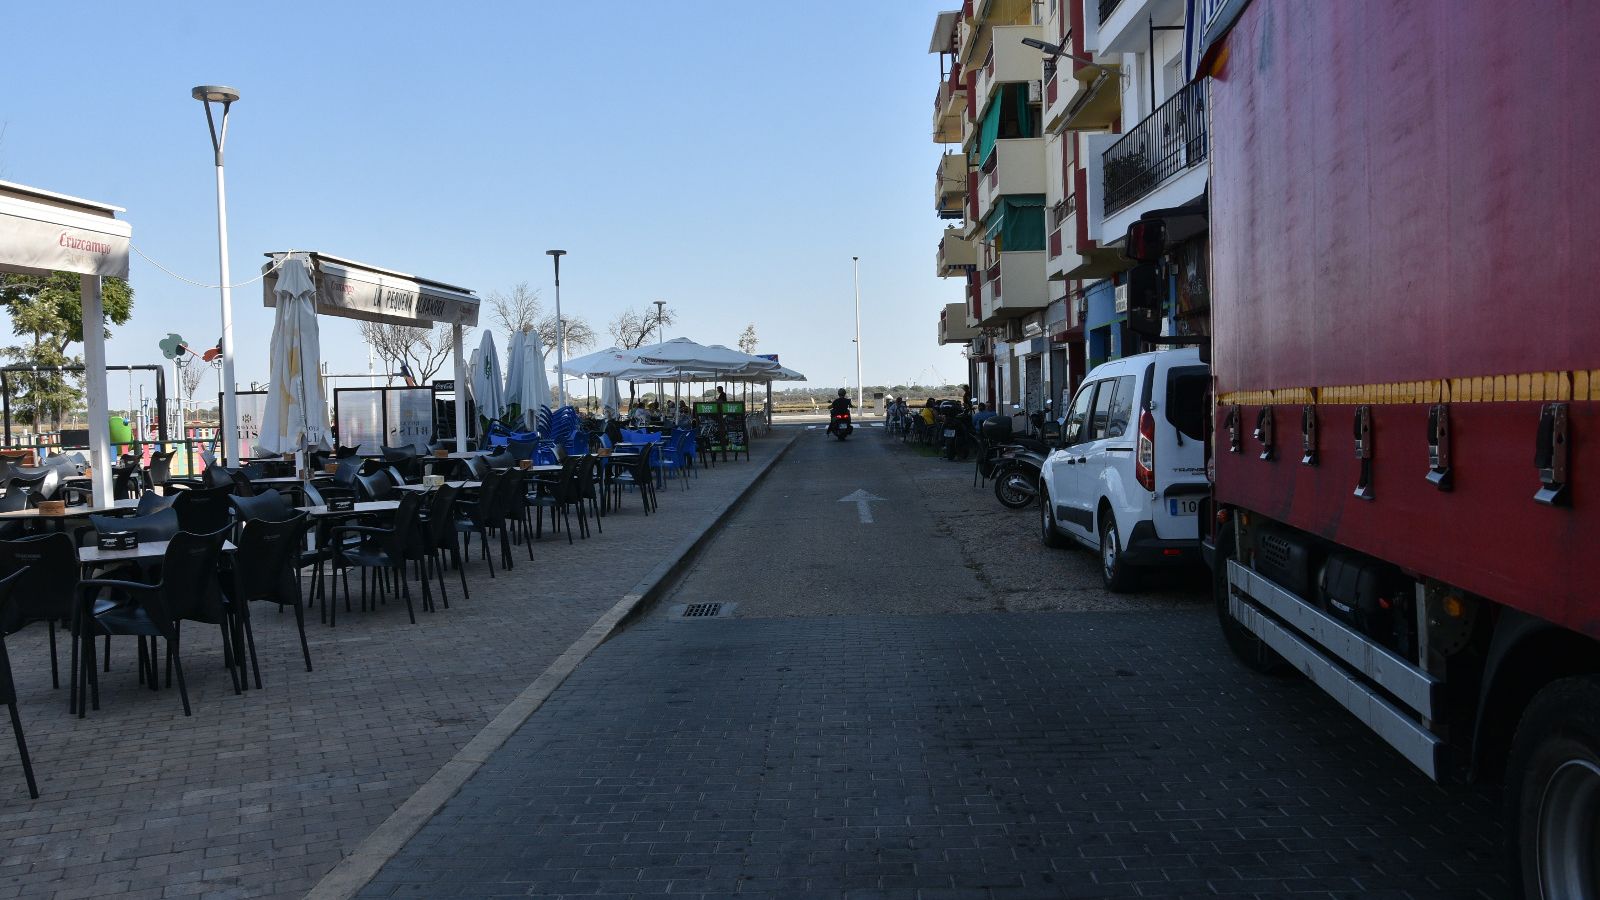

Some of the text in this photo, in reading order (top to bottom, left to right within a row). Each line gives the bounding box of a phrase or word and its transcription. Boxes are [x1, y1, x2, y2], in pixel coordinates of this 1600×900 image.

[59, 232, 112, 256] Cruzcampo
[373, 287, 383, 308] LA
[237, 430, 259, 440] LIS
[1182, 501, 1197, 513] 10
